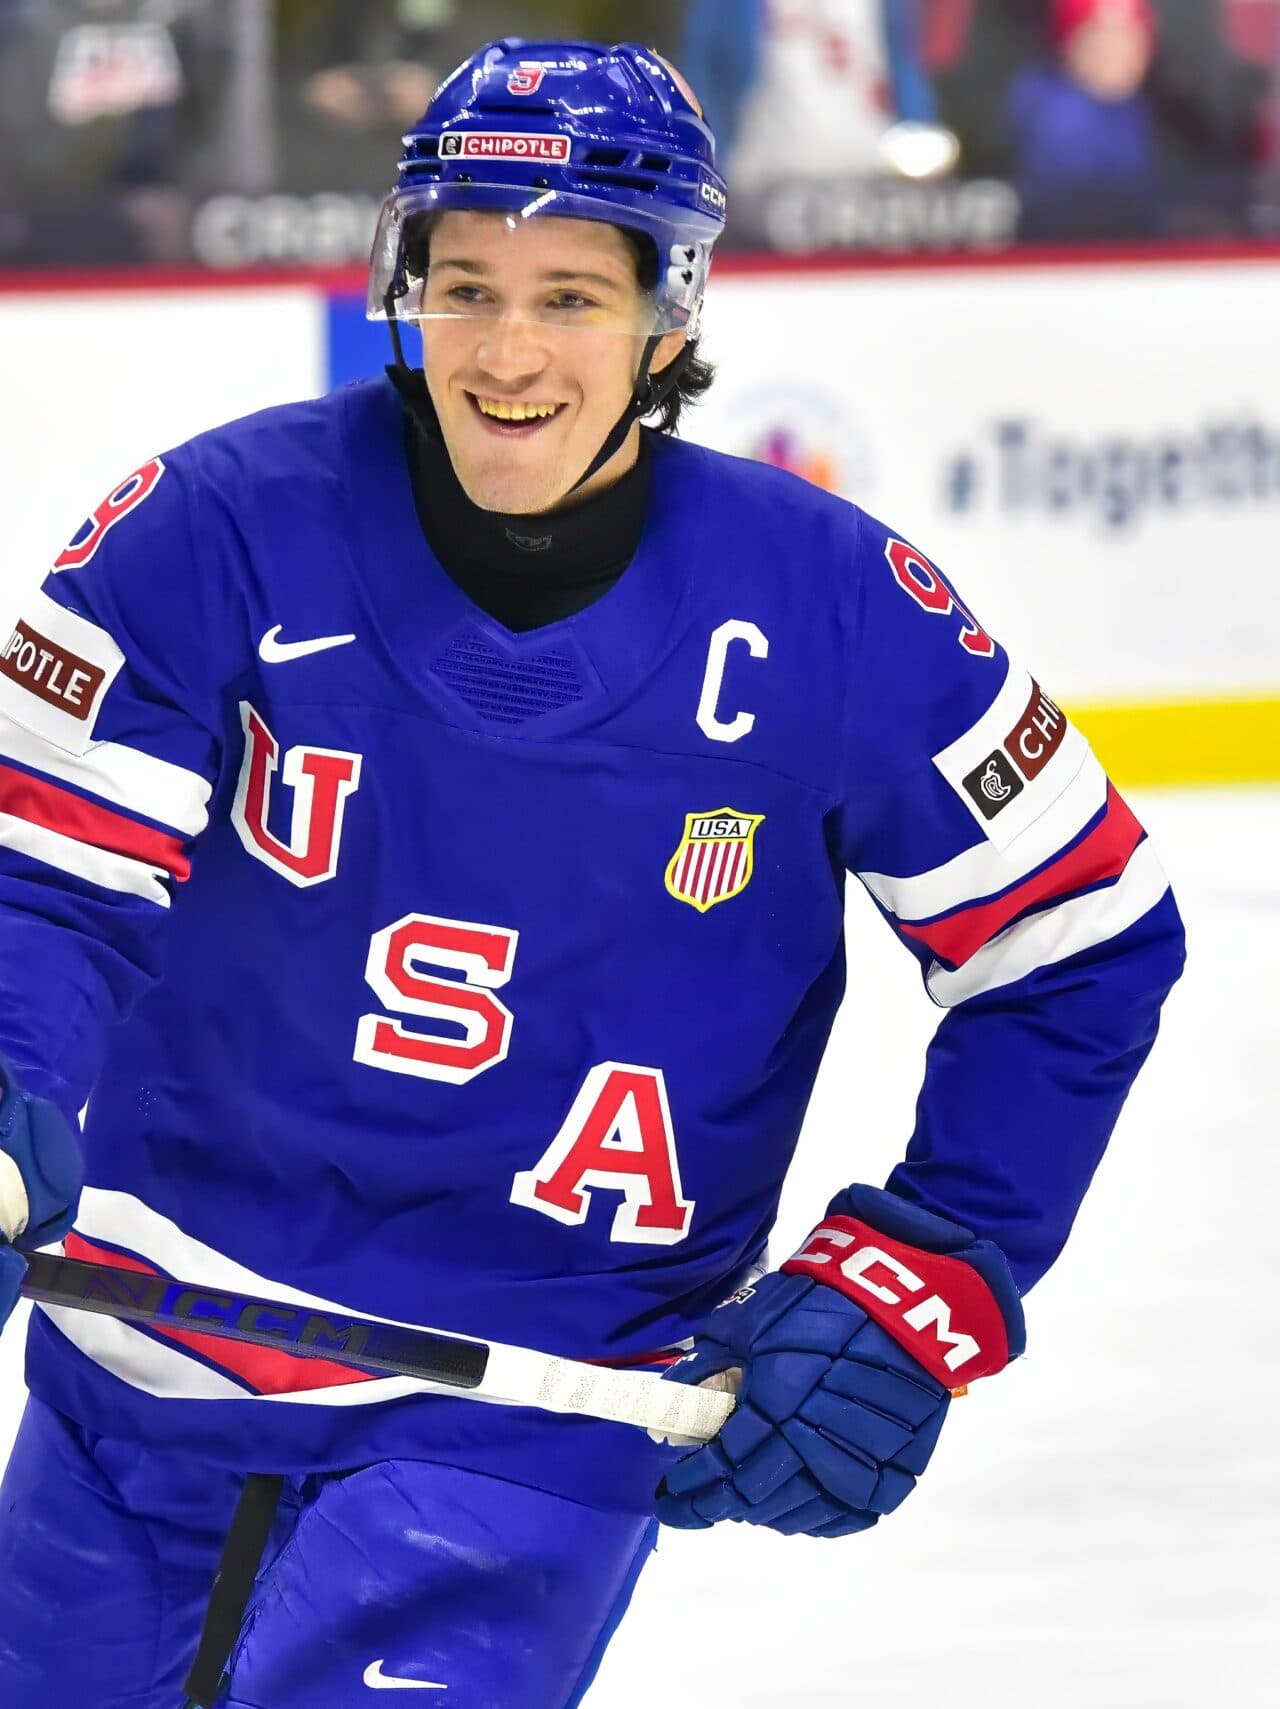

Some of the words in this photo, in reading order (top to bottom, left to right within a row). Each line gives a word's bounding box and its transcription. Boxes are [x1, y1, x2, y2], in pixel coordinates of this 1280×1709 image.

[467, 137, 563, 158] CHIPOTLE
[701, 182, 727, 211] CCM
[51, 456, 166, 574] 9
[883, 537, 995, 658] 9
[696, 618, 769, 743] C
[1019, 690, 1060, 760] CHI
[697, 820, 742, 837] USA
[173, 1287, 372, 1356] CCM
[788, 1228, 982, 1373] CCM
